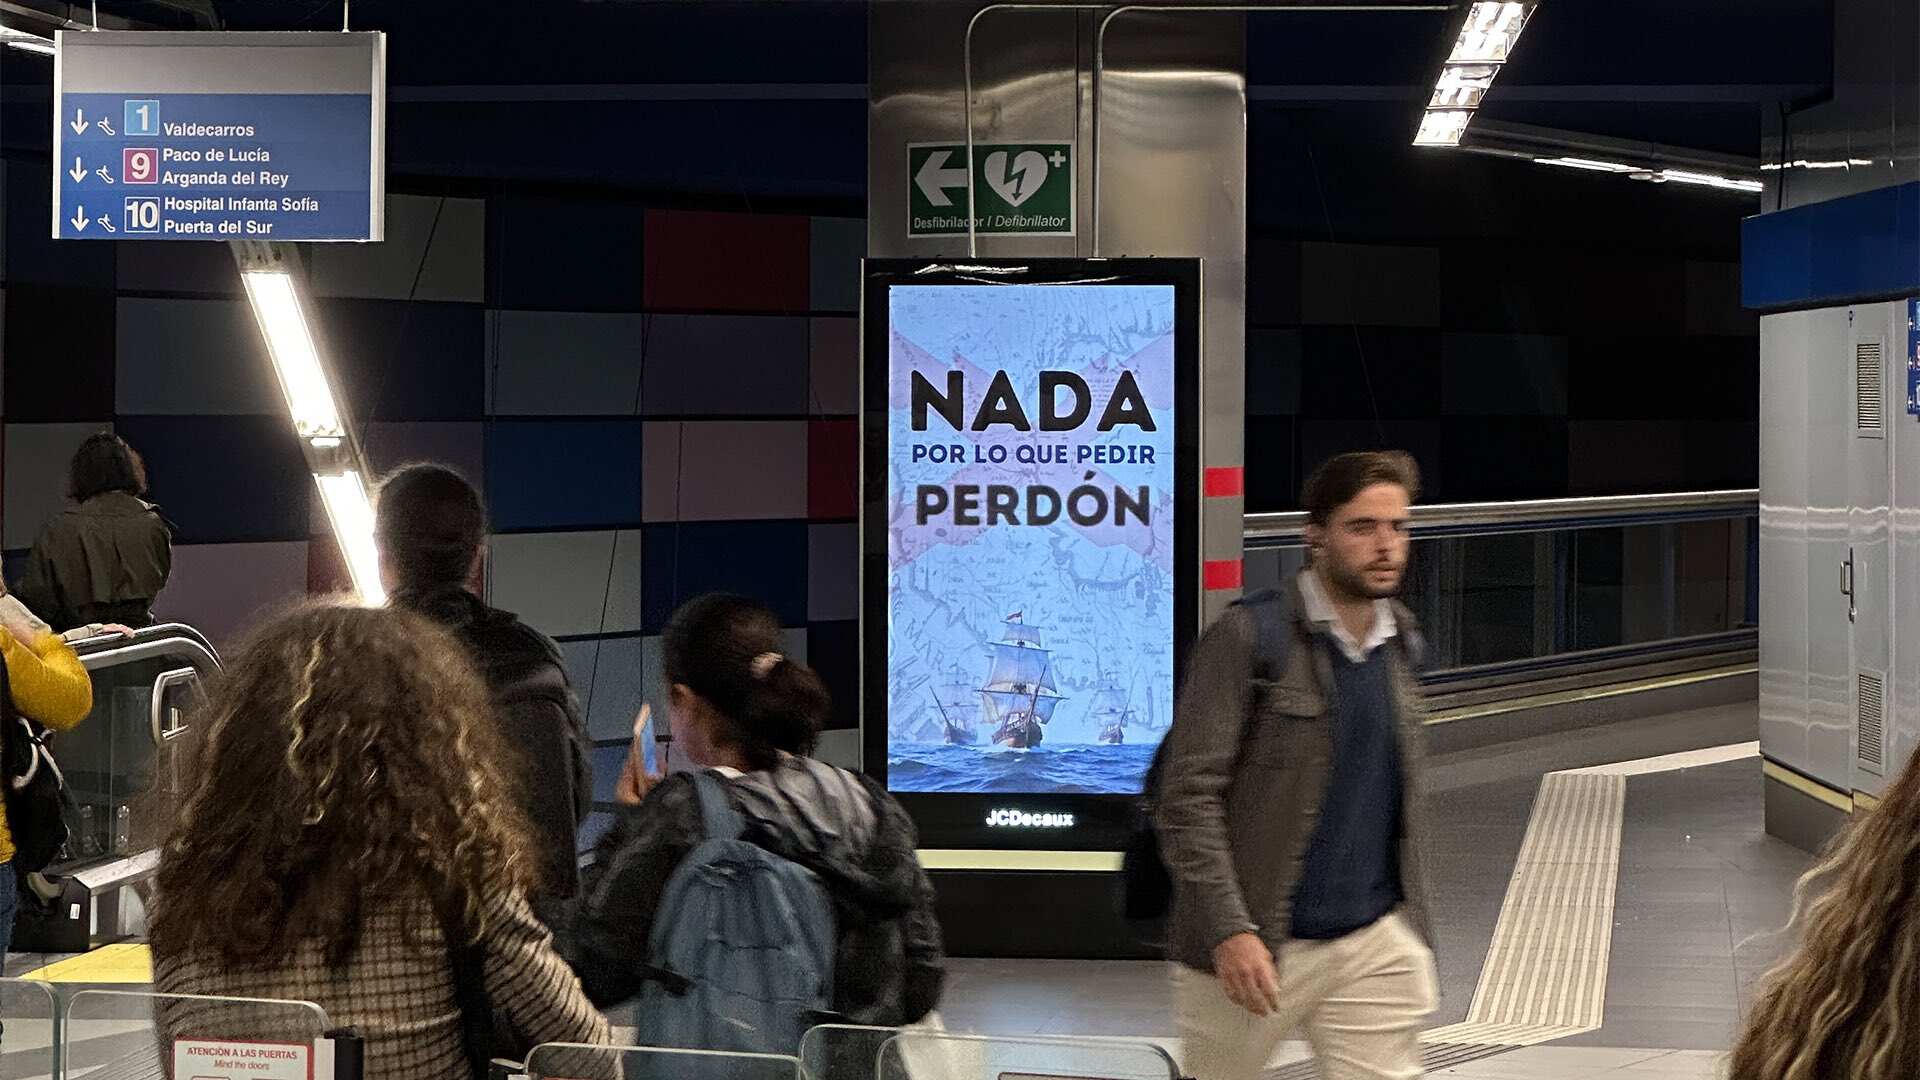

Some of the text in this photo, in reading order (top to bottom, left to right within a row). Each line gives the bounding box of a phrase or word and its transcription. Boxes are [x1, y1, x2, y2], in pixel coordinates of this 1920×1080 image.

[135, 105, 255, 137] 1 Valdecarros
[163, 147, 270, 162] Paco de Lucía
[131, 152, 150, 180] 9
[162, 172, 289, 188] Arganda del Rey
[164, 196, 319, 214] Hospital Infanta Sofía
[126, 201, 158, 229] 10
[995, 215, 1067, 227] Defibrillator
[164, 219, 272, 234] Puerta del Sur
[911, 370, 1157, 432] NADA
[912, 444, 1155, 464] POR LO QUE PEDIR
[916, 469, 1150, 526] PERDÓN
[985, 808, 1074, 827] JCDecaux
[232, 1048, 238, 1057] A
[240, 1049, 257, 1059] LAS
[258, 1050, 297, 1060] PUERTAS
[214, 1059, 270, 1070] Mind the doors
